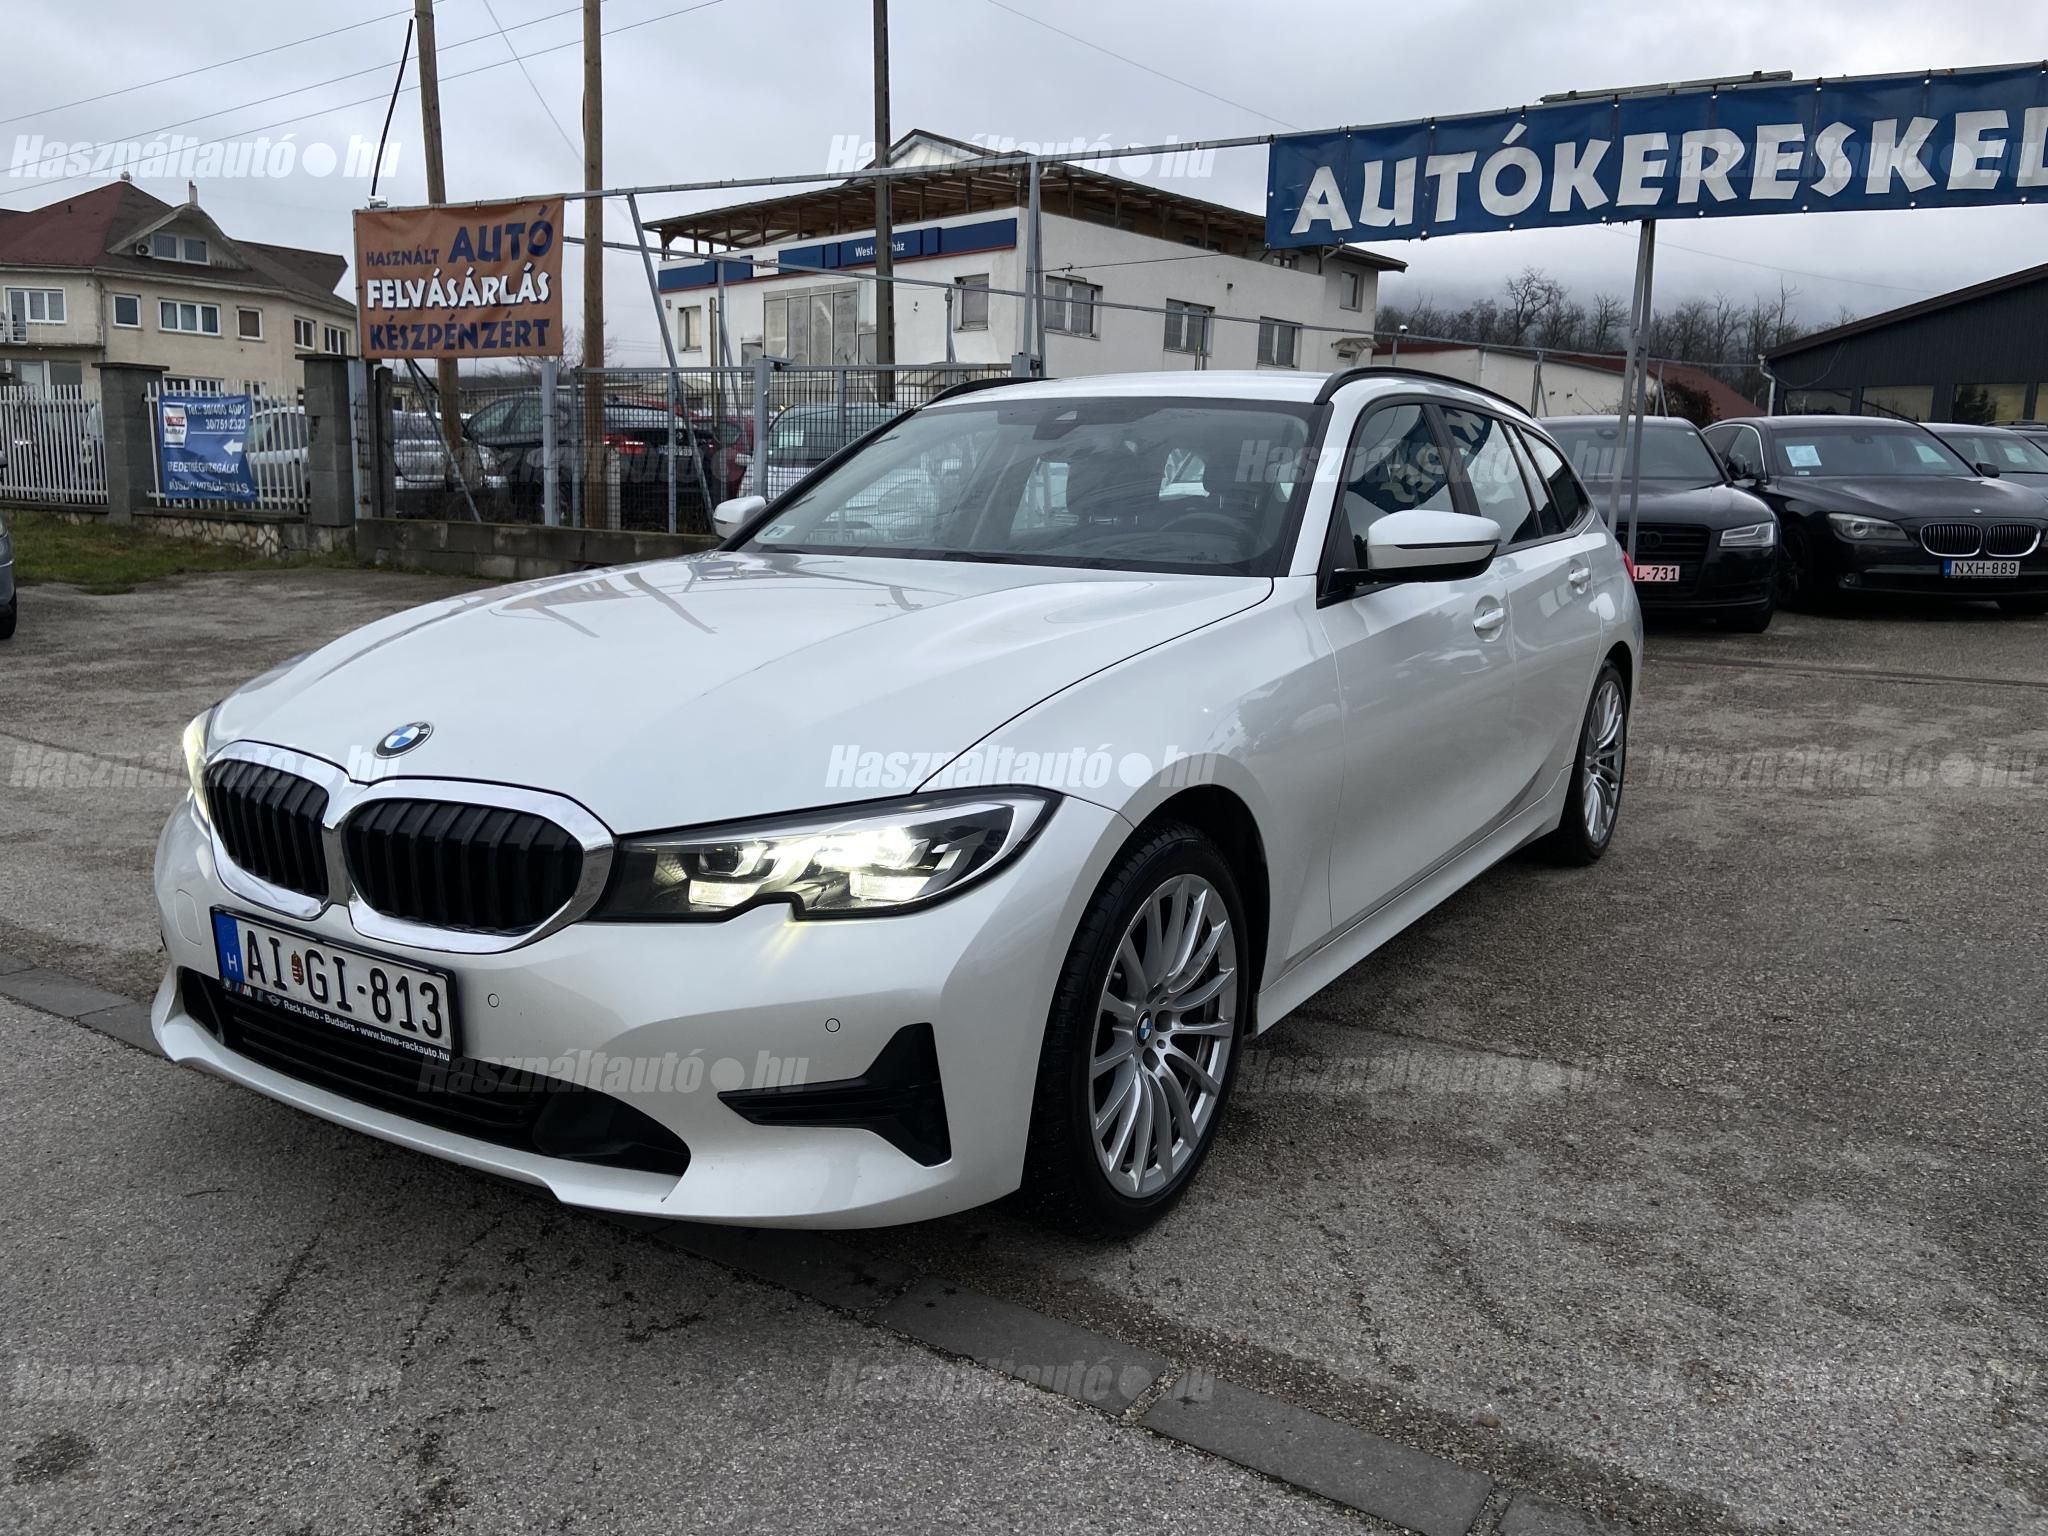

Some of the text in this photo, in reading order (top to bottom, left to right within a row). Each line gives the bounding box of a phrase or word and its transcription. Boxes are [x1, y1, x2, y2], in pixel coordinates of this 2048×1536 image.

[366, 205, 553, 266] HASZNÁLT AUTÓ
[855, 245, 874, 257] West
[367, 262, 551, 309] FELVÁSÁRLÁS
[369, 310, 550, 350] KÉSZPÉNZÉRT
[1633, 567, 1676, 581] L-731
[1954, 562, 2017, 575] NXH-889
[226, 951, 238, 972] H
[304, 948, 443, 1039] GI-813
[284, 1000, 301, 1013] Rack
[303, 1007, 320, 1020] Autó
[324, 1013, 356, 1032] Budaörs
[360, 1027, 450, 1061] www.bmw-rackauto.hu
